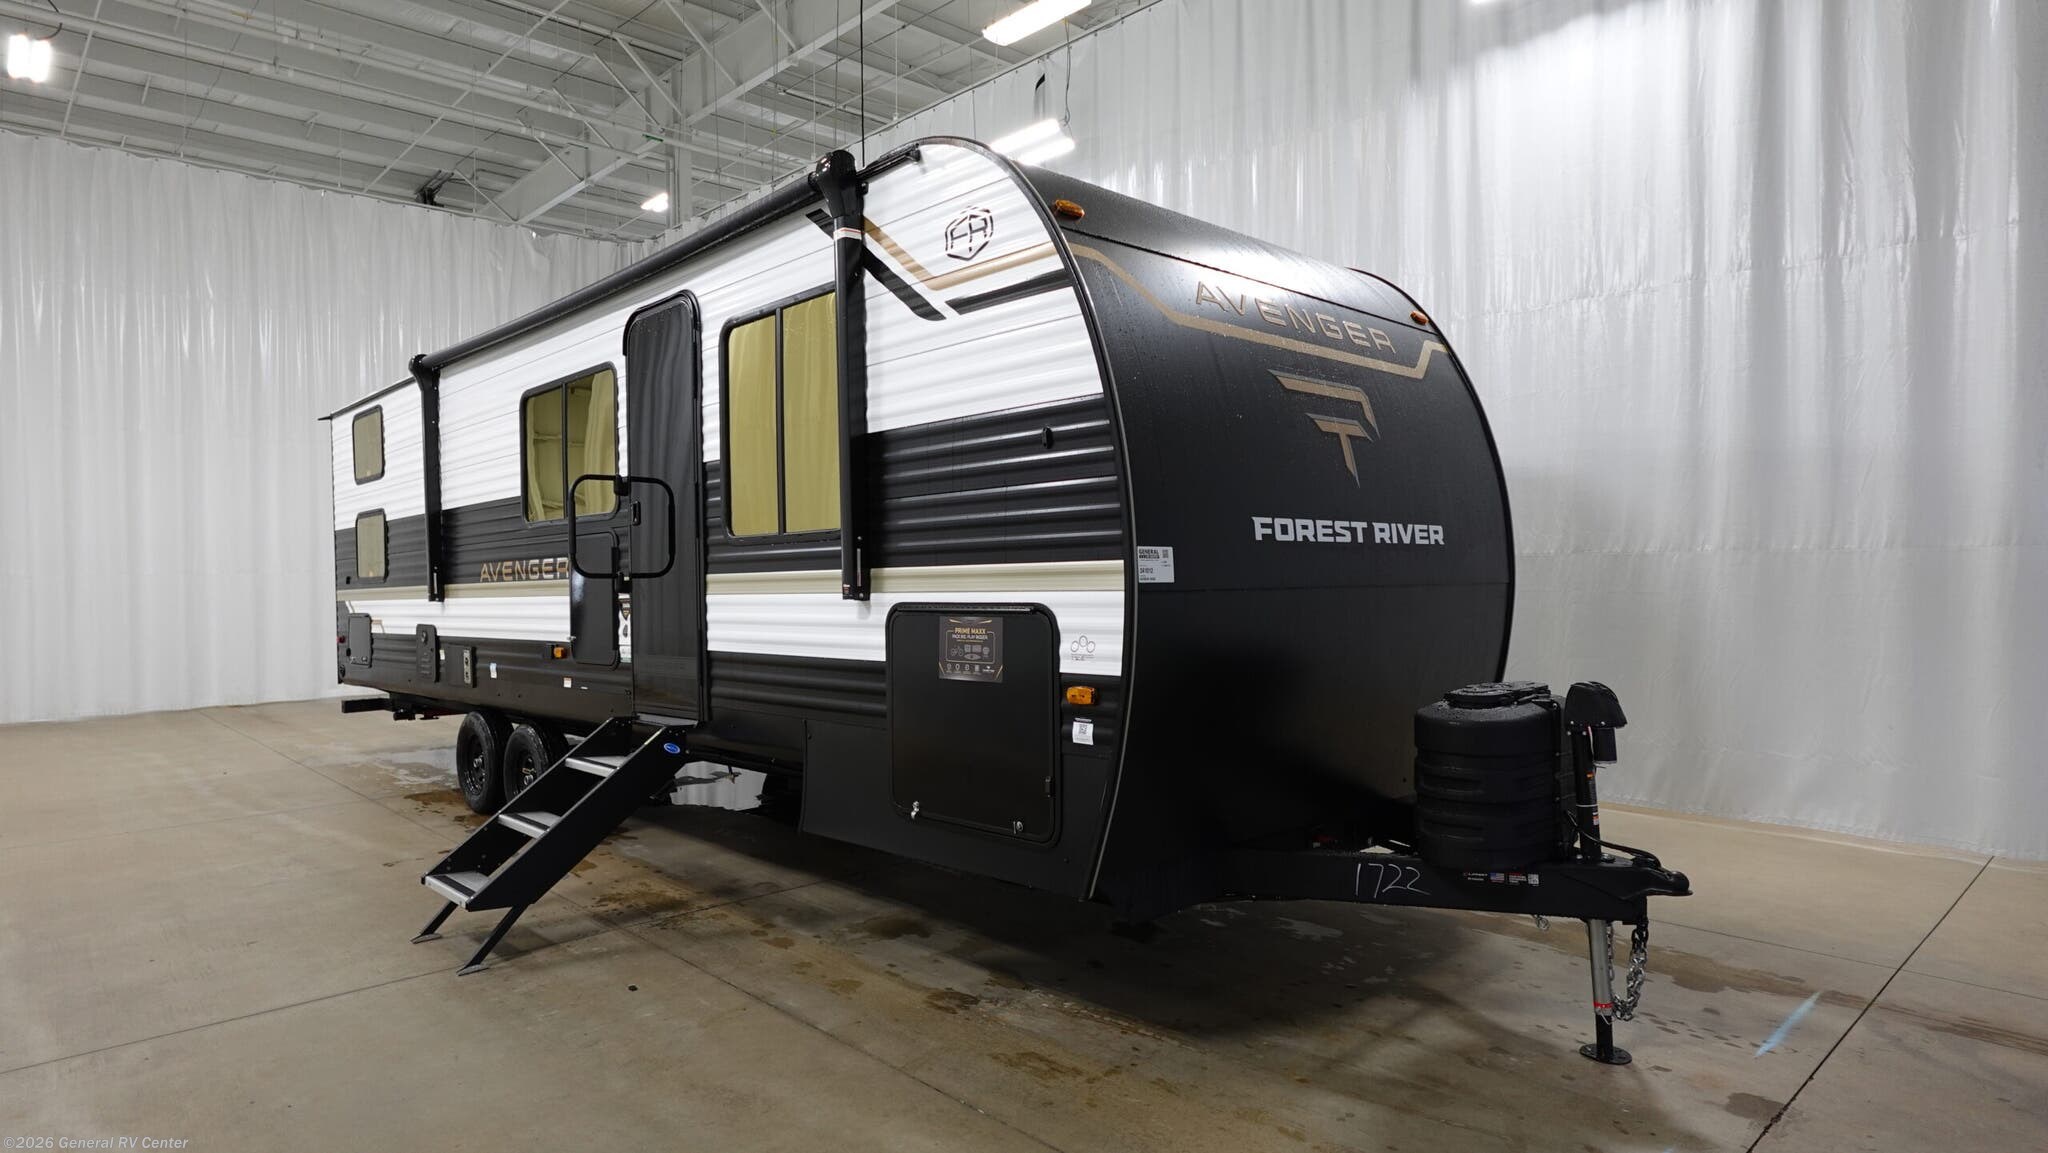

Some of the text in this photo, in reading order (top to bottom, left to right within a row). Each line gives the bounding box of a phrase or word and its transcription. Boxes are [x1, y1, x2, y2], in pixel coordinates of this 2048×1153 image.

[1196, 281, 1396, 354] AVENGER
[1251, 516, 1445, 545] FOREST RIVER
[480, 557, 569, 582] AVENGER
[1355, 863, 1431, 899] 1722
